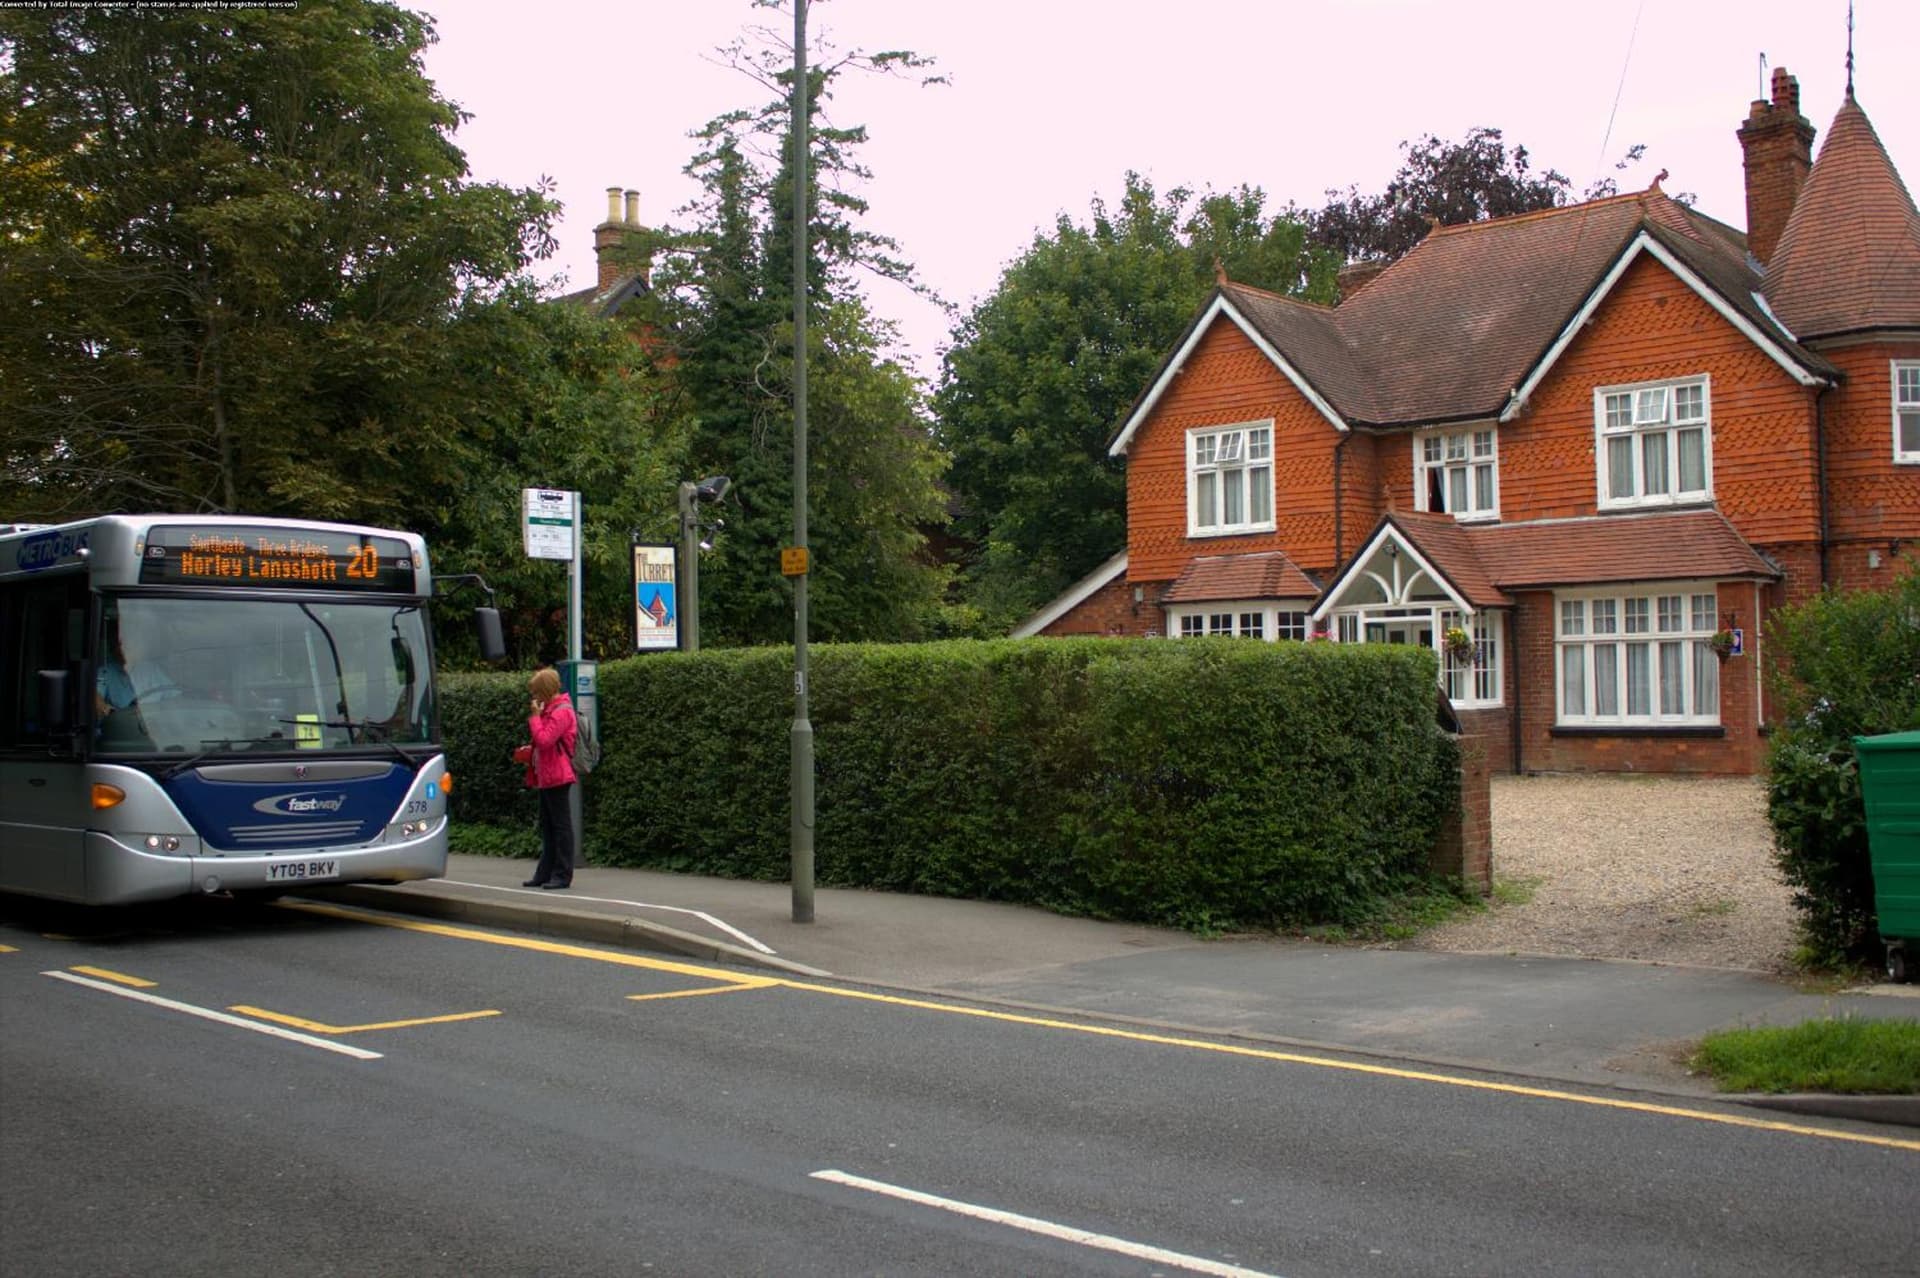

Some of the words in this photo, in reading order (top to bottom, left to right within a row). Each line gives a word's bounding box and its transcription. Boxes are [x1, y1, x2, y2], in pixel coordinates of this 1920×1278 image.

[19, 531, 88, 564] METROBUS
[257, 536, 287, 557] Three
[181, 551, 244, 577] Horley
[346, 544, 379, 579] 20
[636, 553, 675, 582] TURRET
[287, 796, 345, 812] fastway
[408, 801, 428, 814] 578
[270, 863, 306, 879] YT09
[309, 861, 335, 876] BKV
